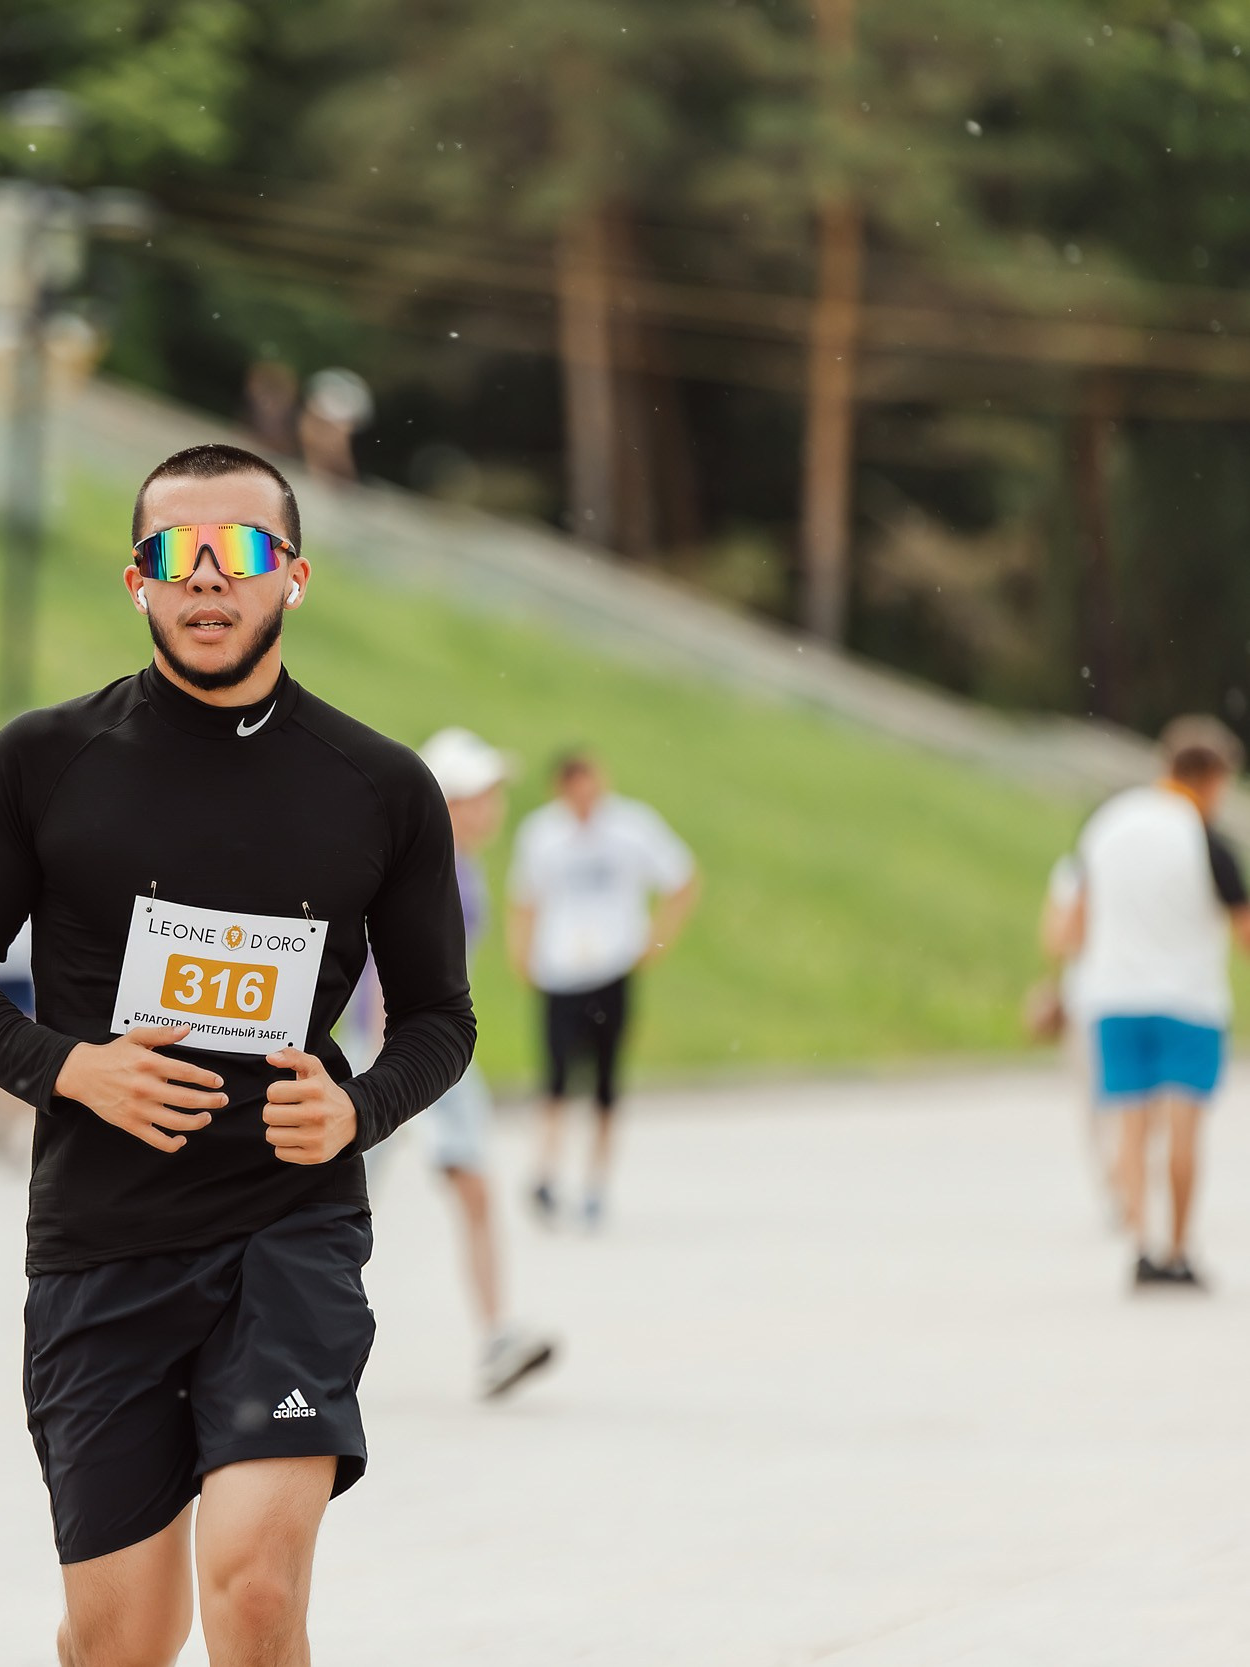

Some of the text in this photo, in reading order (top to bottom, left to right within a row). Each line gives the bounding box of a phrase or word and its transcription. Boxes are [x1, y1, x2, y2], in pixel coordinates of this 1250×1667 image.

[148, 918, 306, 952] LEONE D'ORO
[174, 963, 265, 1013] 316
[257, 1029, 288, 1040] ЗАБЕГ
[273, 1407, 317, 1419] adidas
